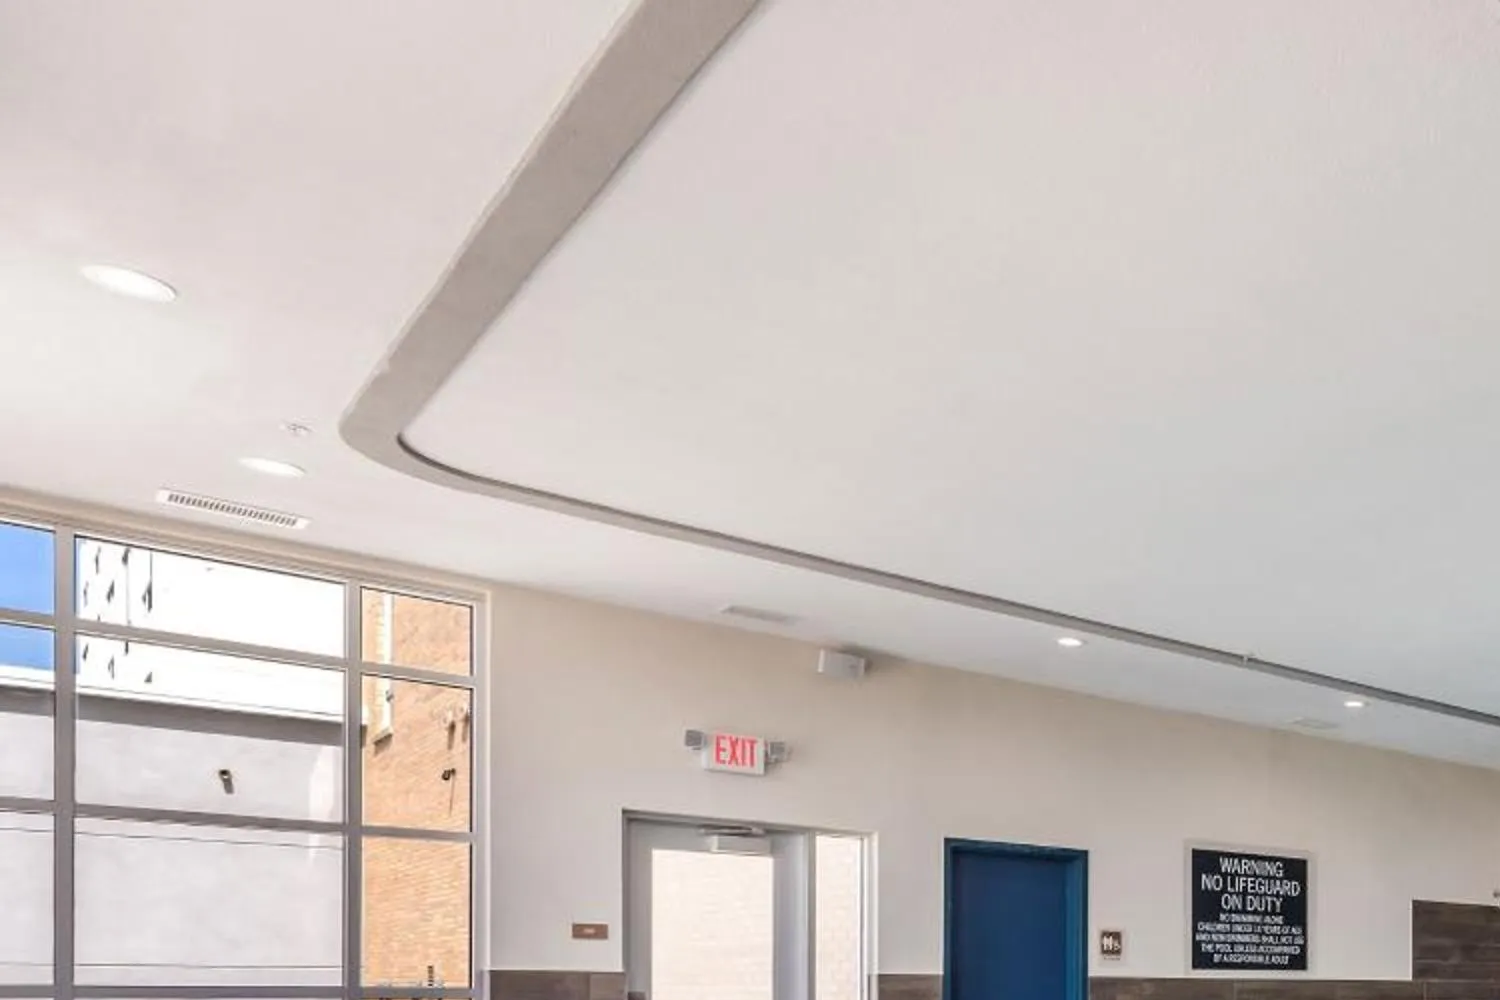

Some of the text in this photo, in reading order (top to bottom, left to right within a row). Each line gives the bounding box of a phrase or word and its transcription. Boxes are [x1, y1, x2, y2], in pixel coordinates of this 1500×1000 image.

[715, 735, 757, 768] EXIT
[1219, 857, 1284, 878] WARNING
[1201, 873, 1301, 897] NO LIFEGUARD
[1221, 893, 1283, 913] ON DUTY
